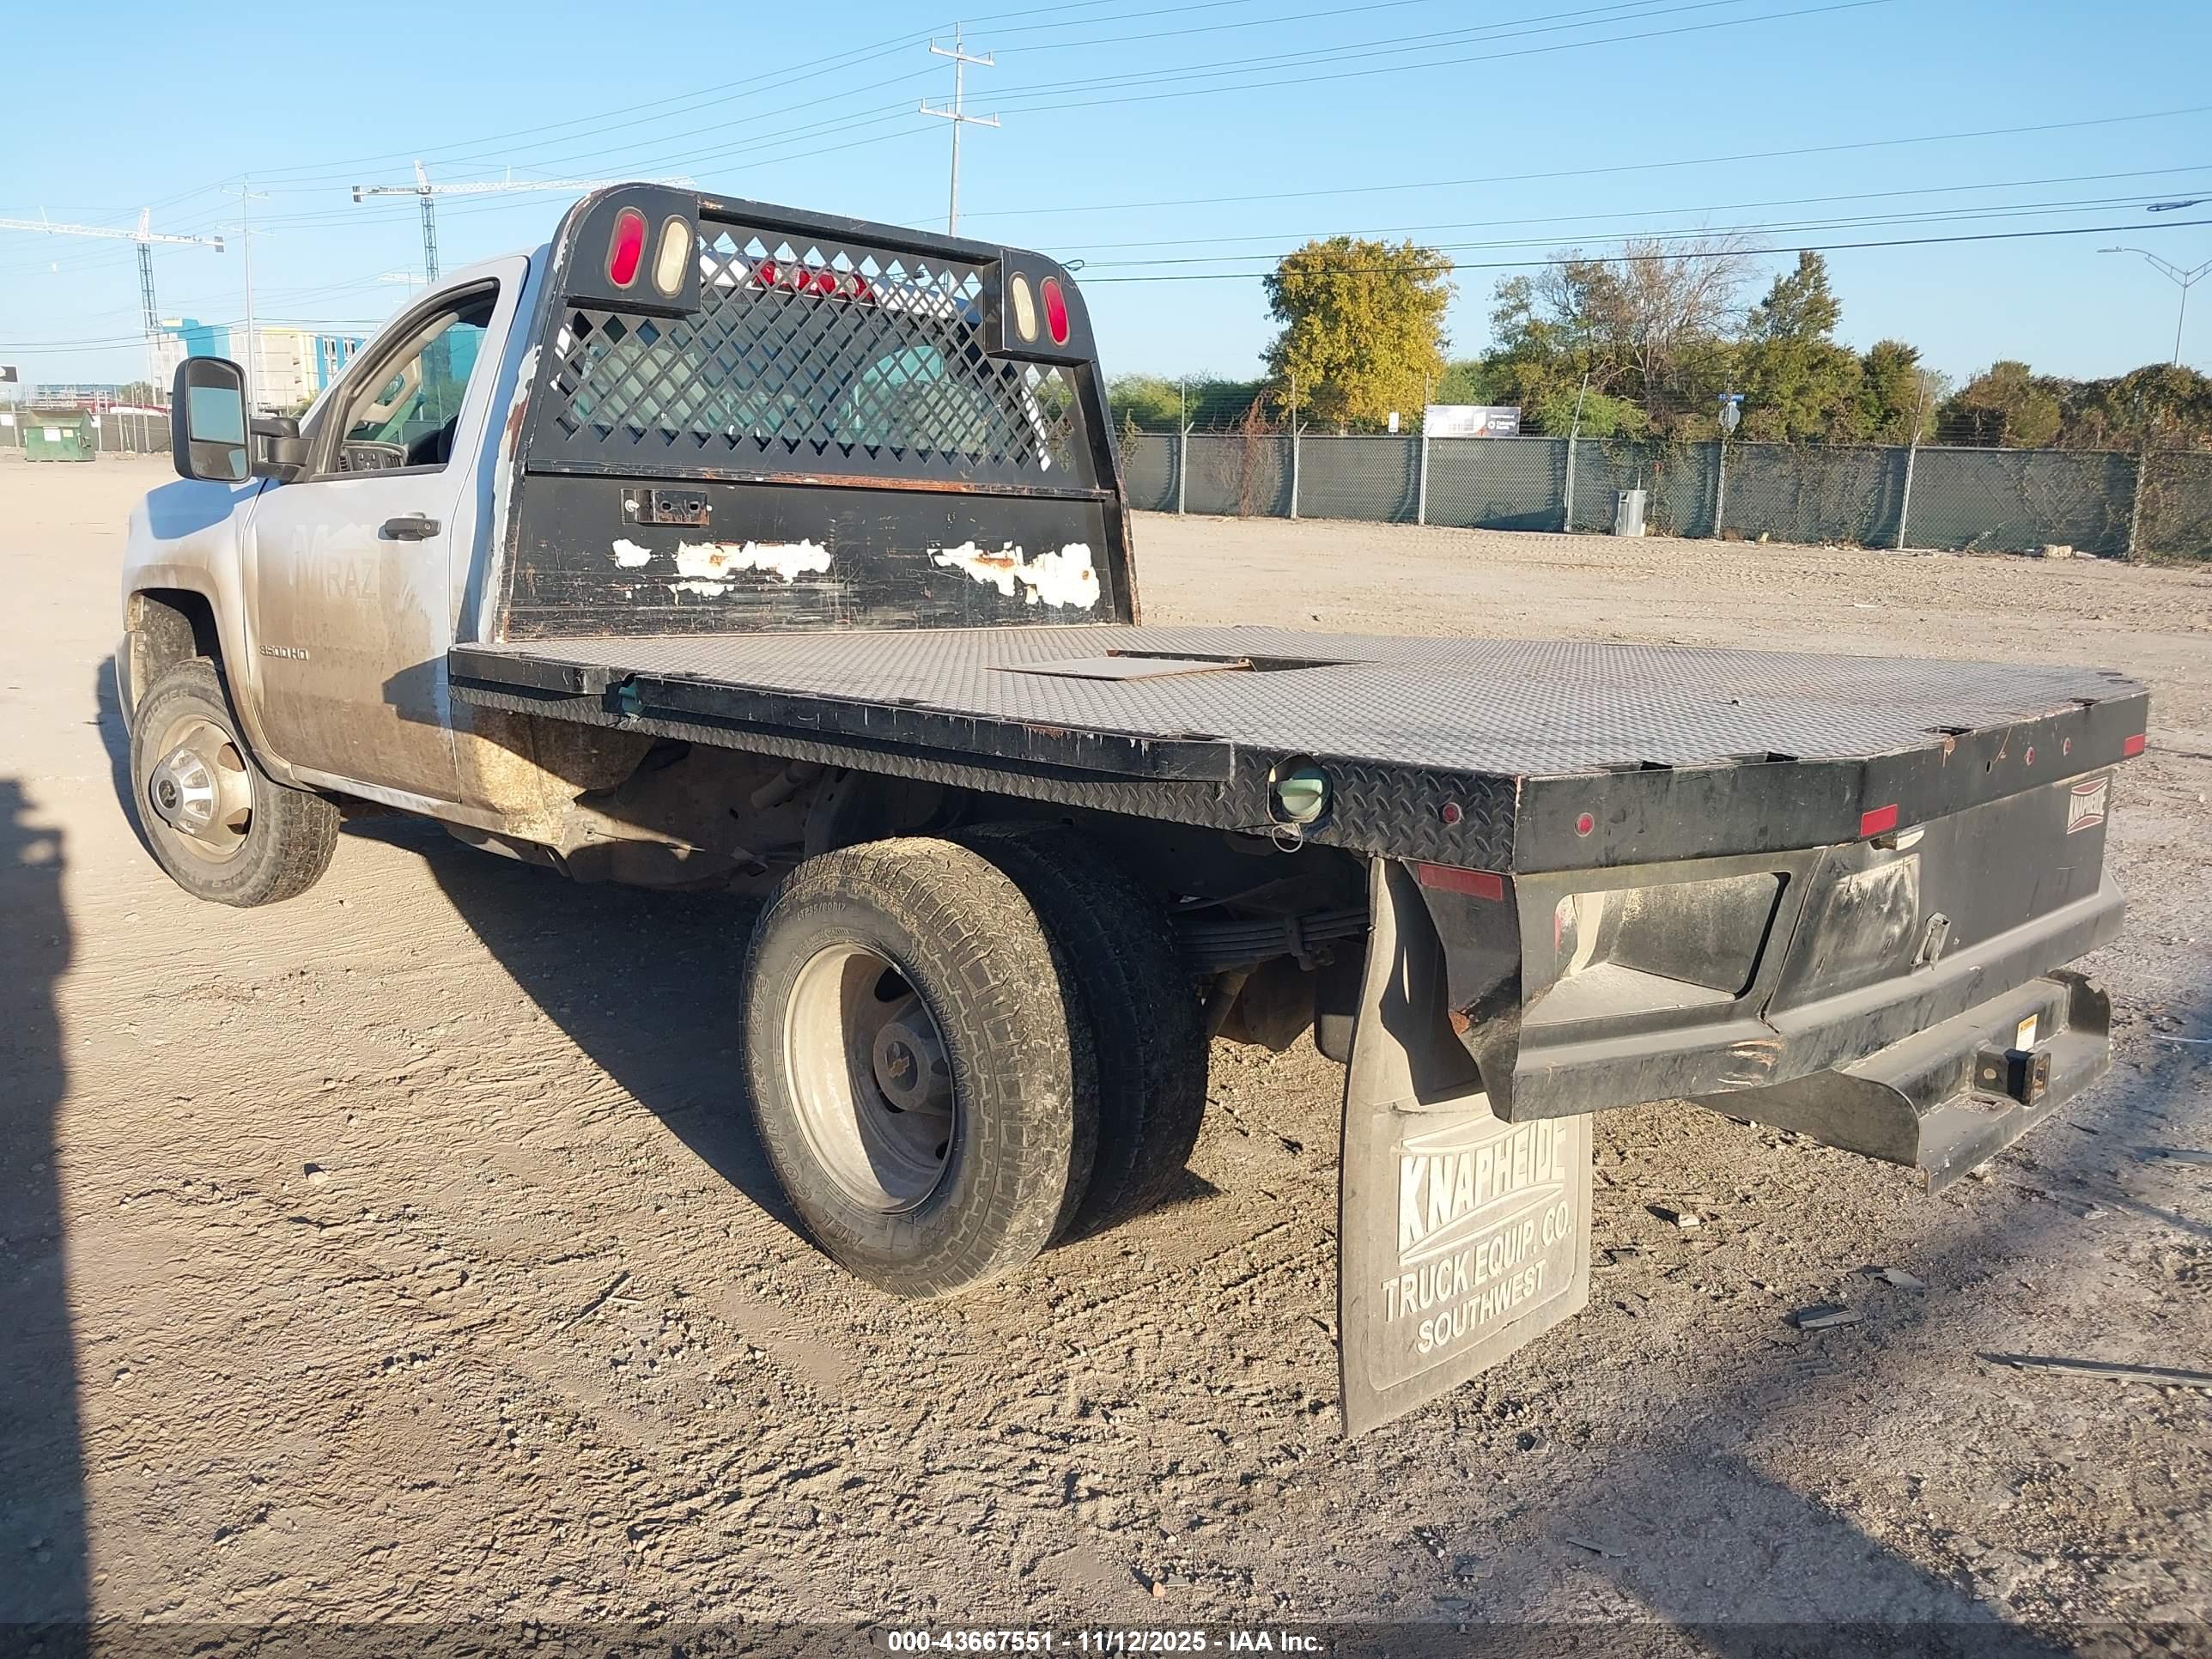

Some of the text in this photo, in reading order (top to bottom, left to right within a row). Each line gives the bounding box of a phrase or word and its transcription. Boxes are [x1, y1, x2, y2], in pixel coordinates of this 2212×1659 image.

[259, 645, 309, 661] 3500 HD
[1396, 1118, 1567, 1253] KNAPHEIDE
[1381, 1200, 1572, 1323] TRUCK EQUIP. CO.
[1417, 1259, 1547, 1354] SOUTHWEST
